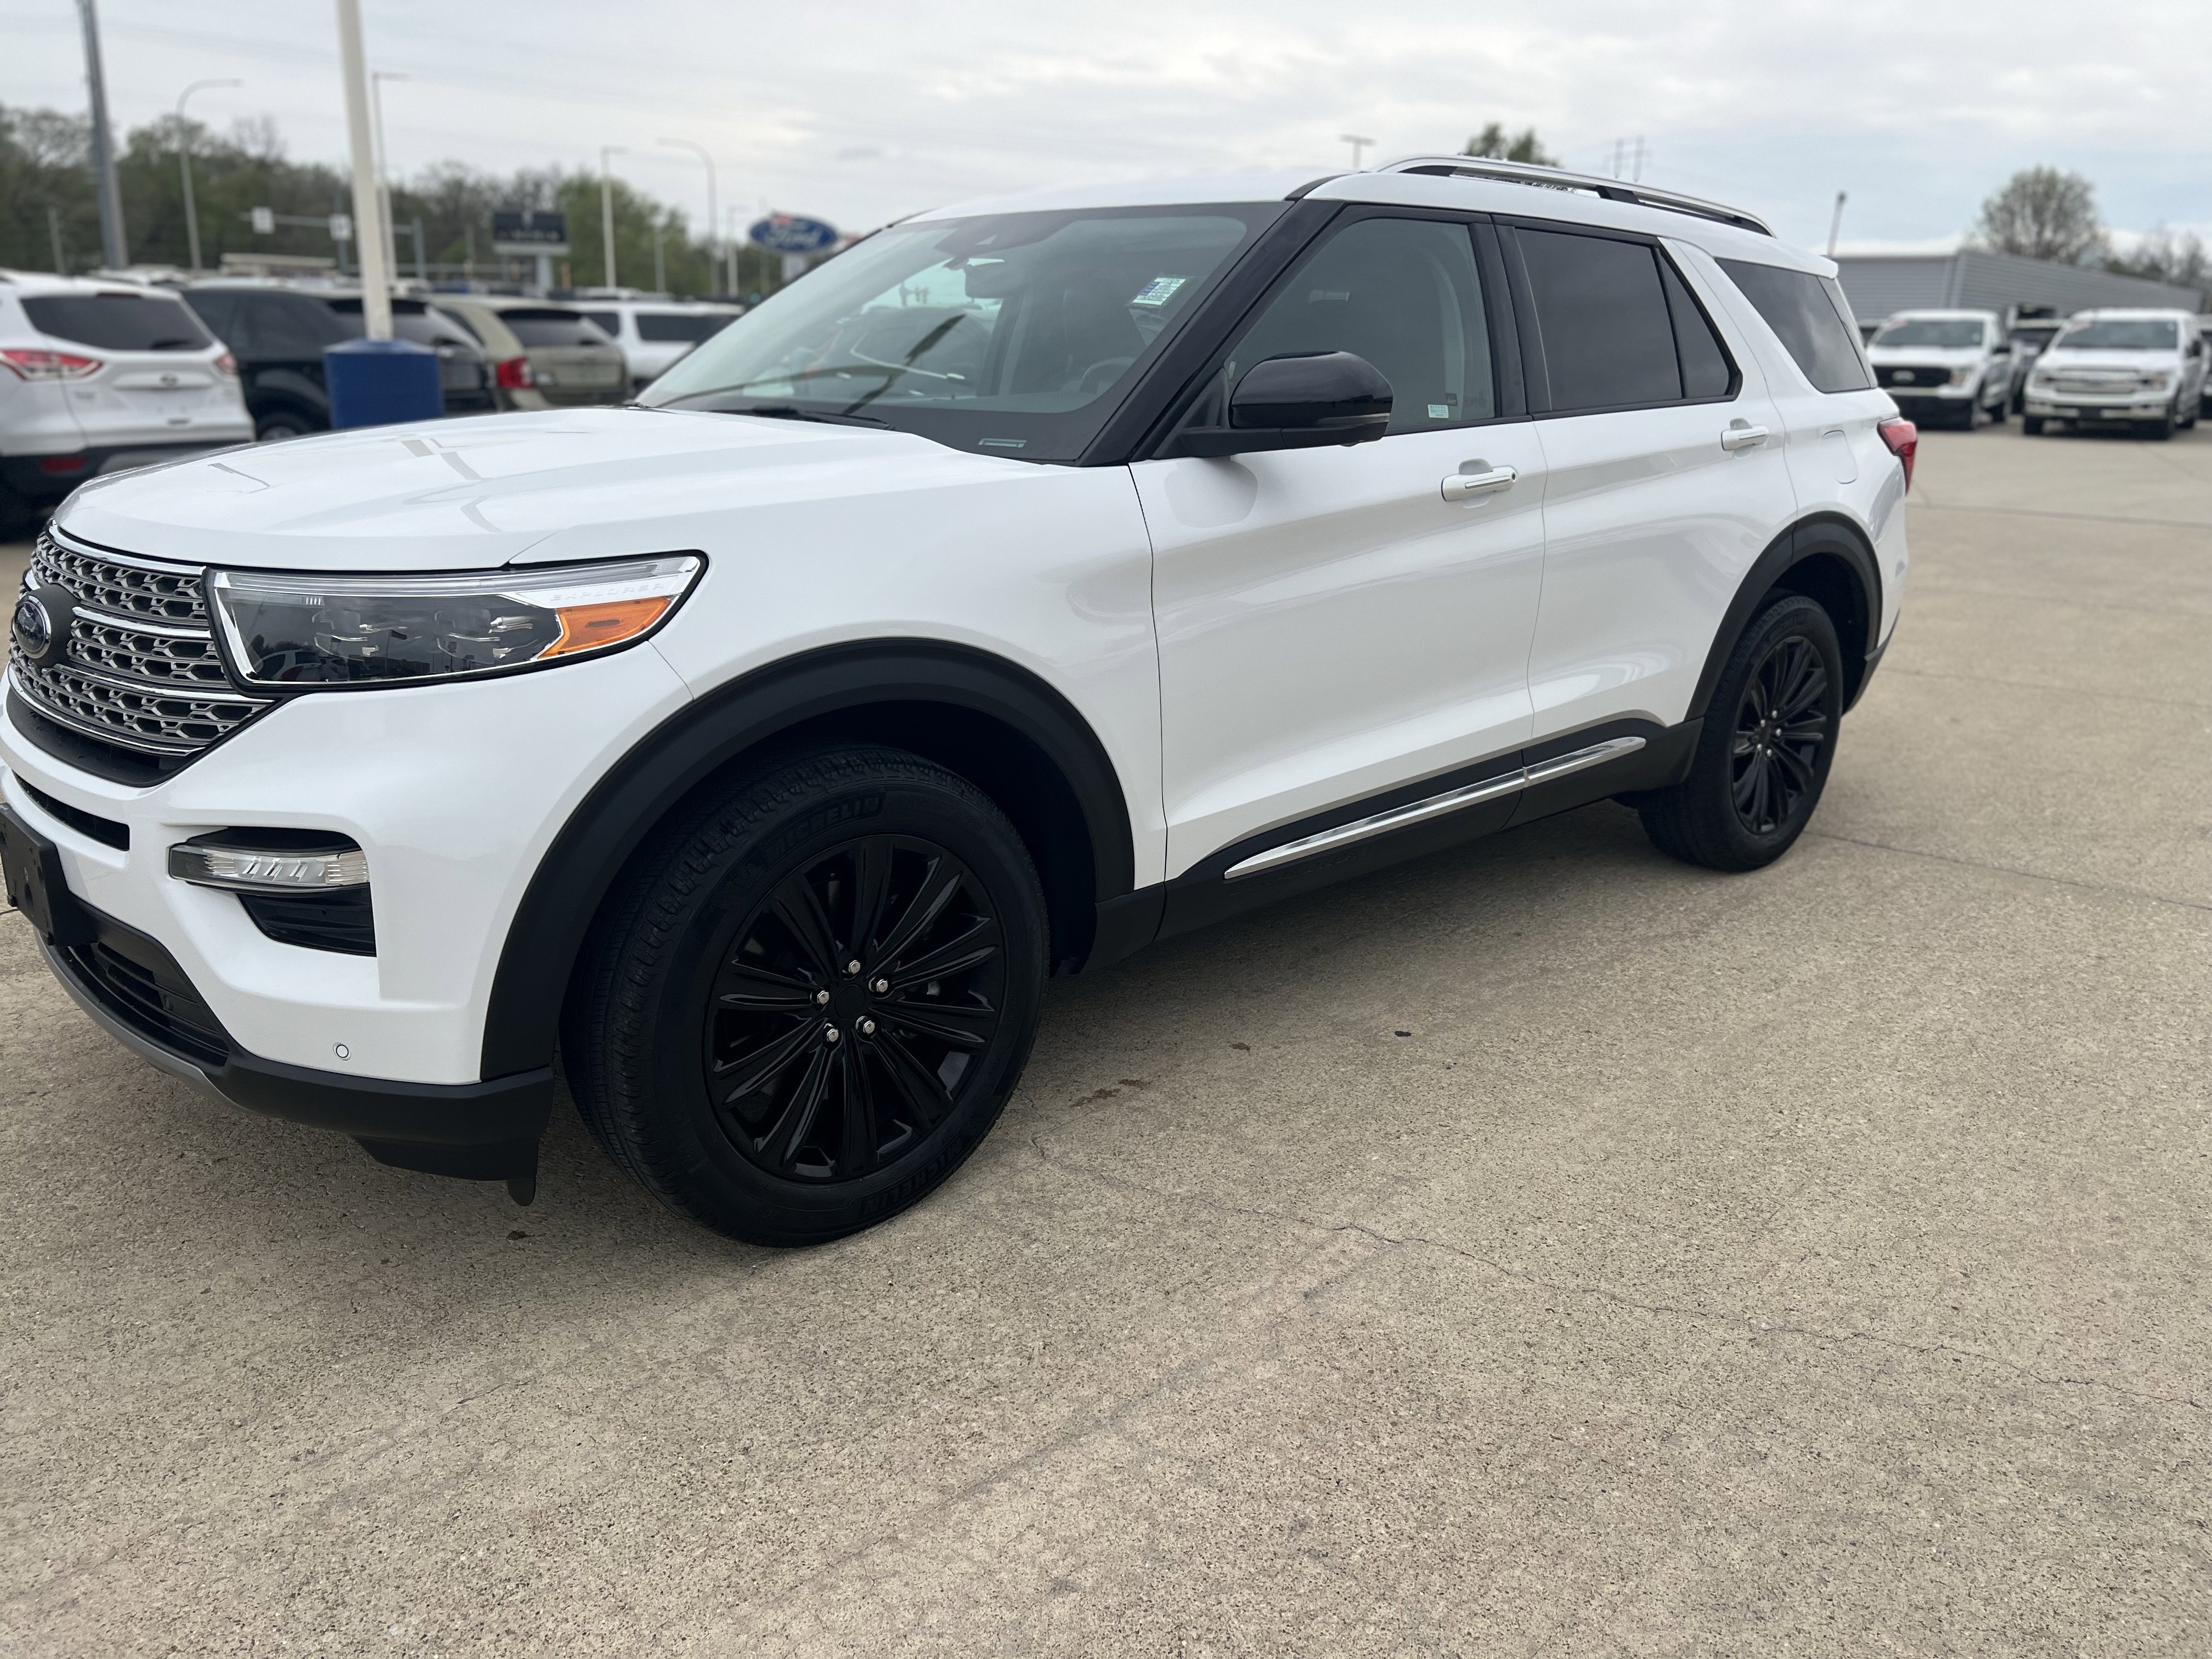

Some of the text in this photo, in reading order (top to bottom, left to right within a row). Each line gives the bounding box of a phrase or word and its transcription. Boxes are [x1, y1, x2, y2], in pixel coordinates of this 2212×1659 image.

[551, 583, 664, 601] EXPLORER
[765, 797, 881, 865] MICHELIN
[863, 1137, 963, 1215] MICHELIN
